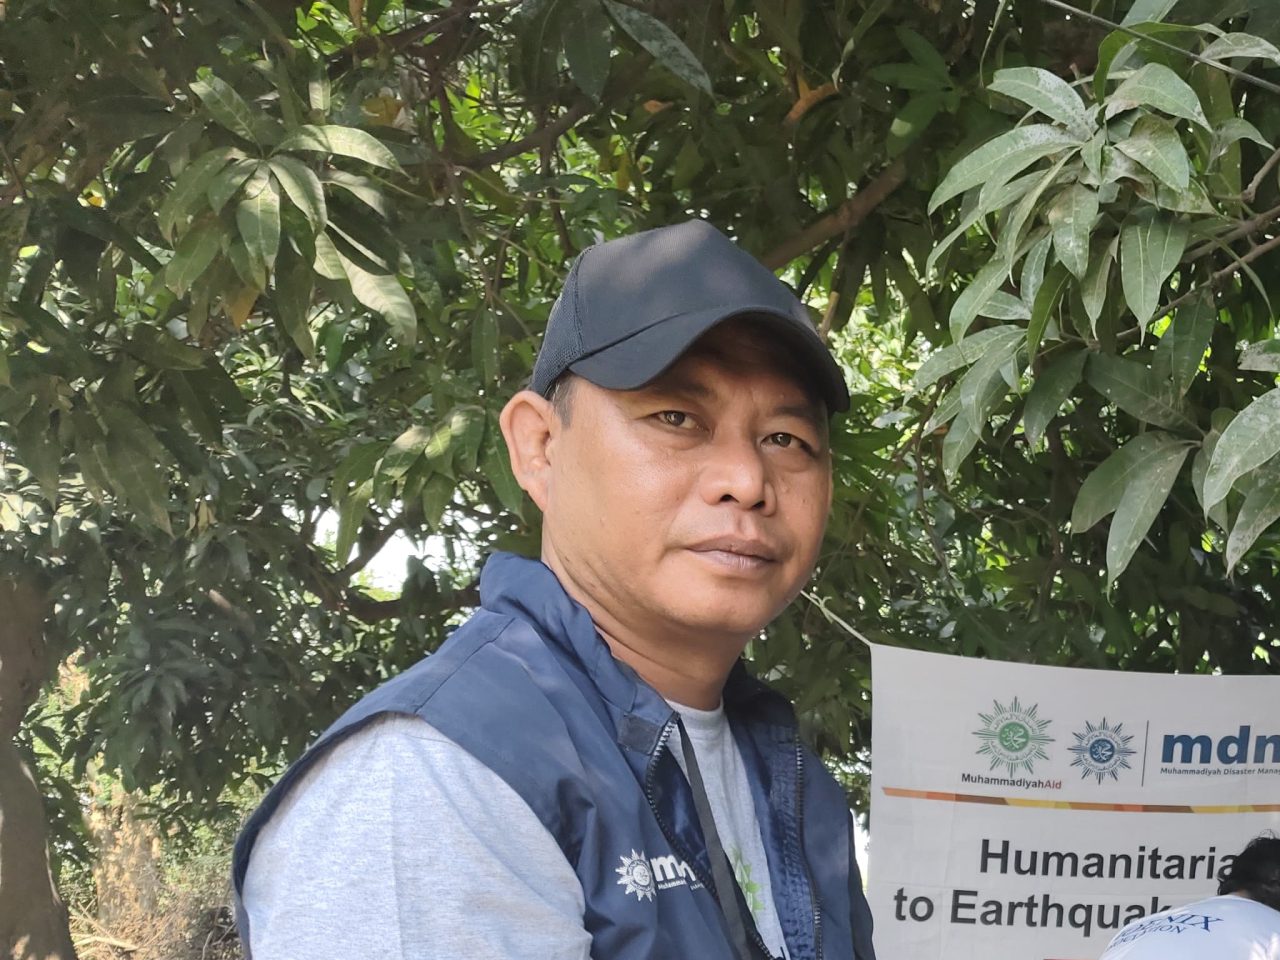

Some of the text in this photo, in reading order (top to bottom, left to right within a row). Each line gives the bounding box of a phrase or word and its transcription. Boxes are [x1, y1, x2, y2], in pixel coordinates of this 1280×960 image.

[961, 772, 1062, 790] MuhammadiyahAid
[1160, 767, 1222, 777] Muhammadiyah
[1223, 767, 1256, 776] Disaster
[979, 838, 1239, 880] Humanitaria
[893, 886, 935, 922] to
